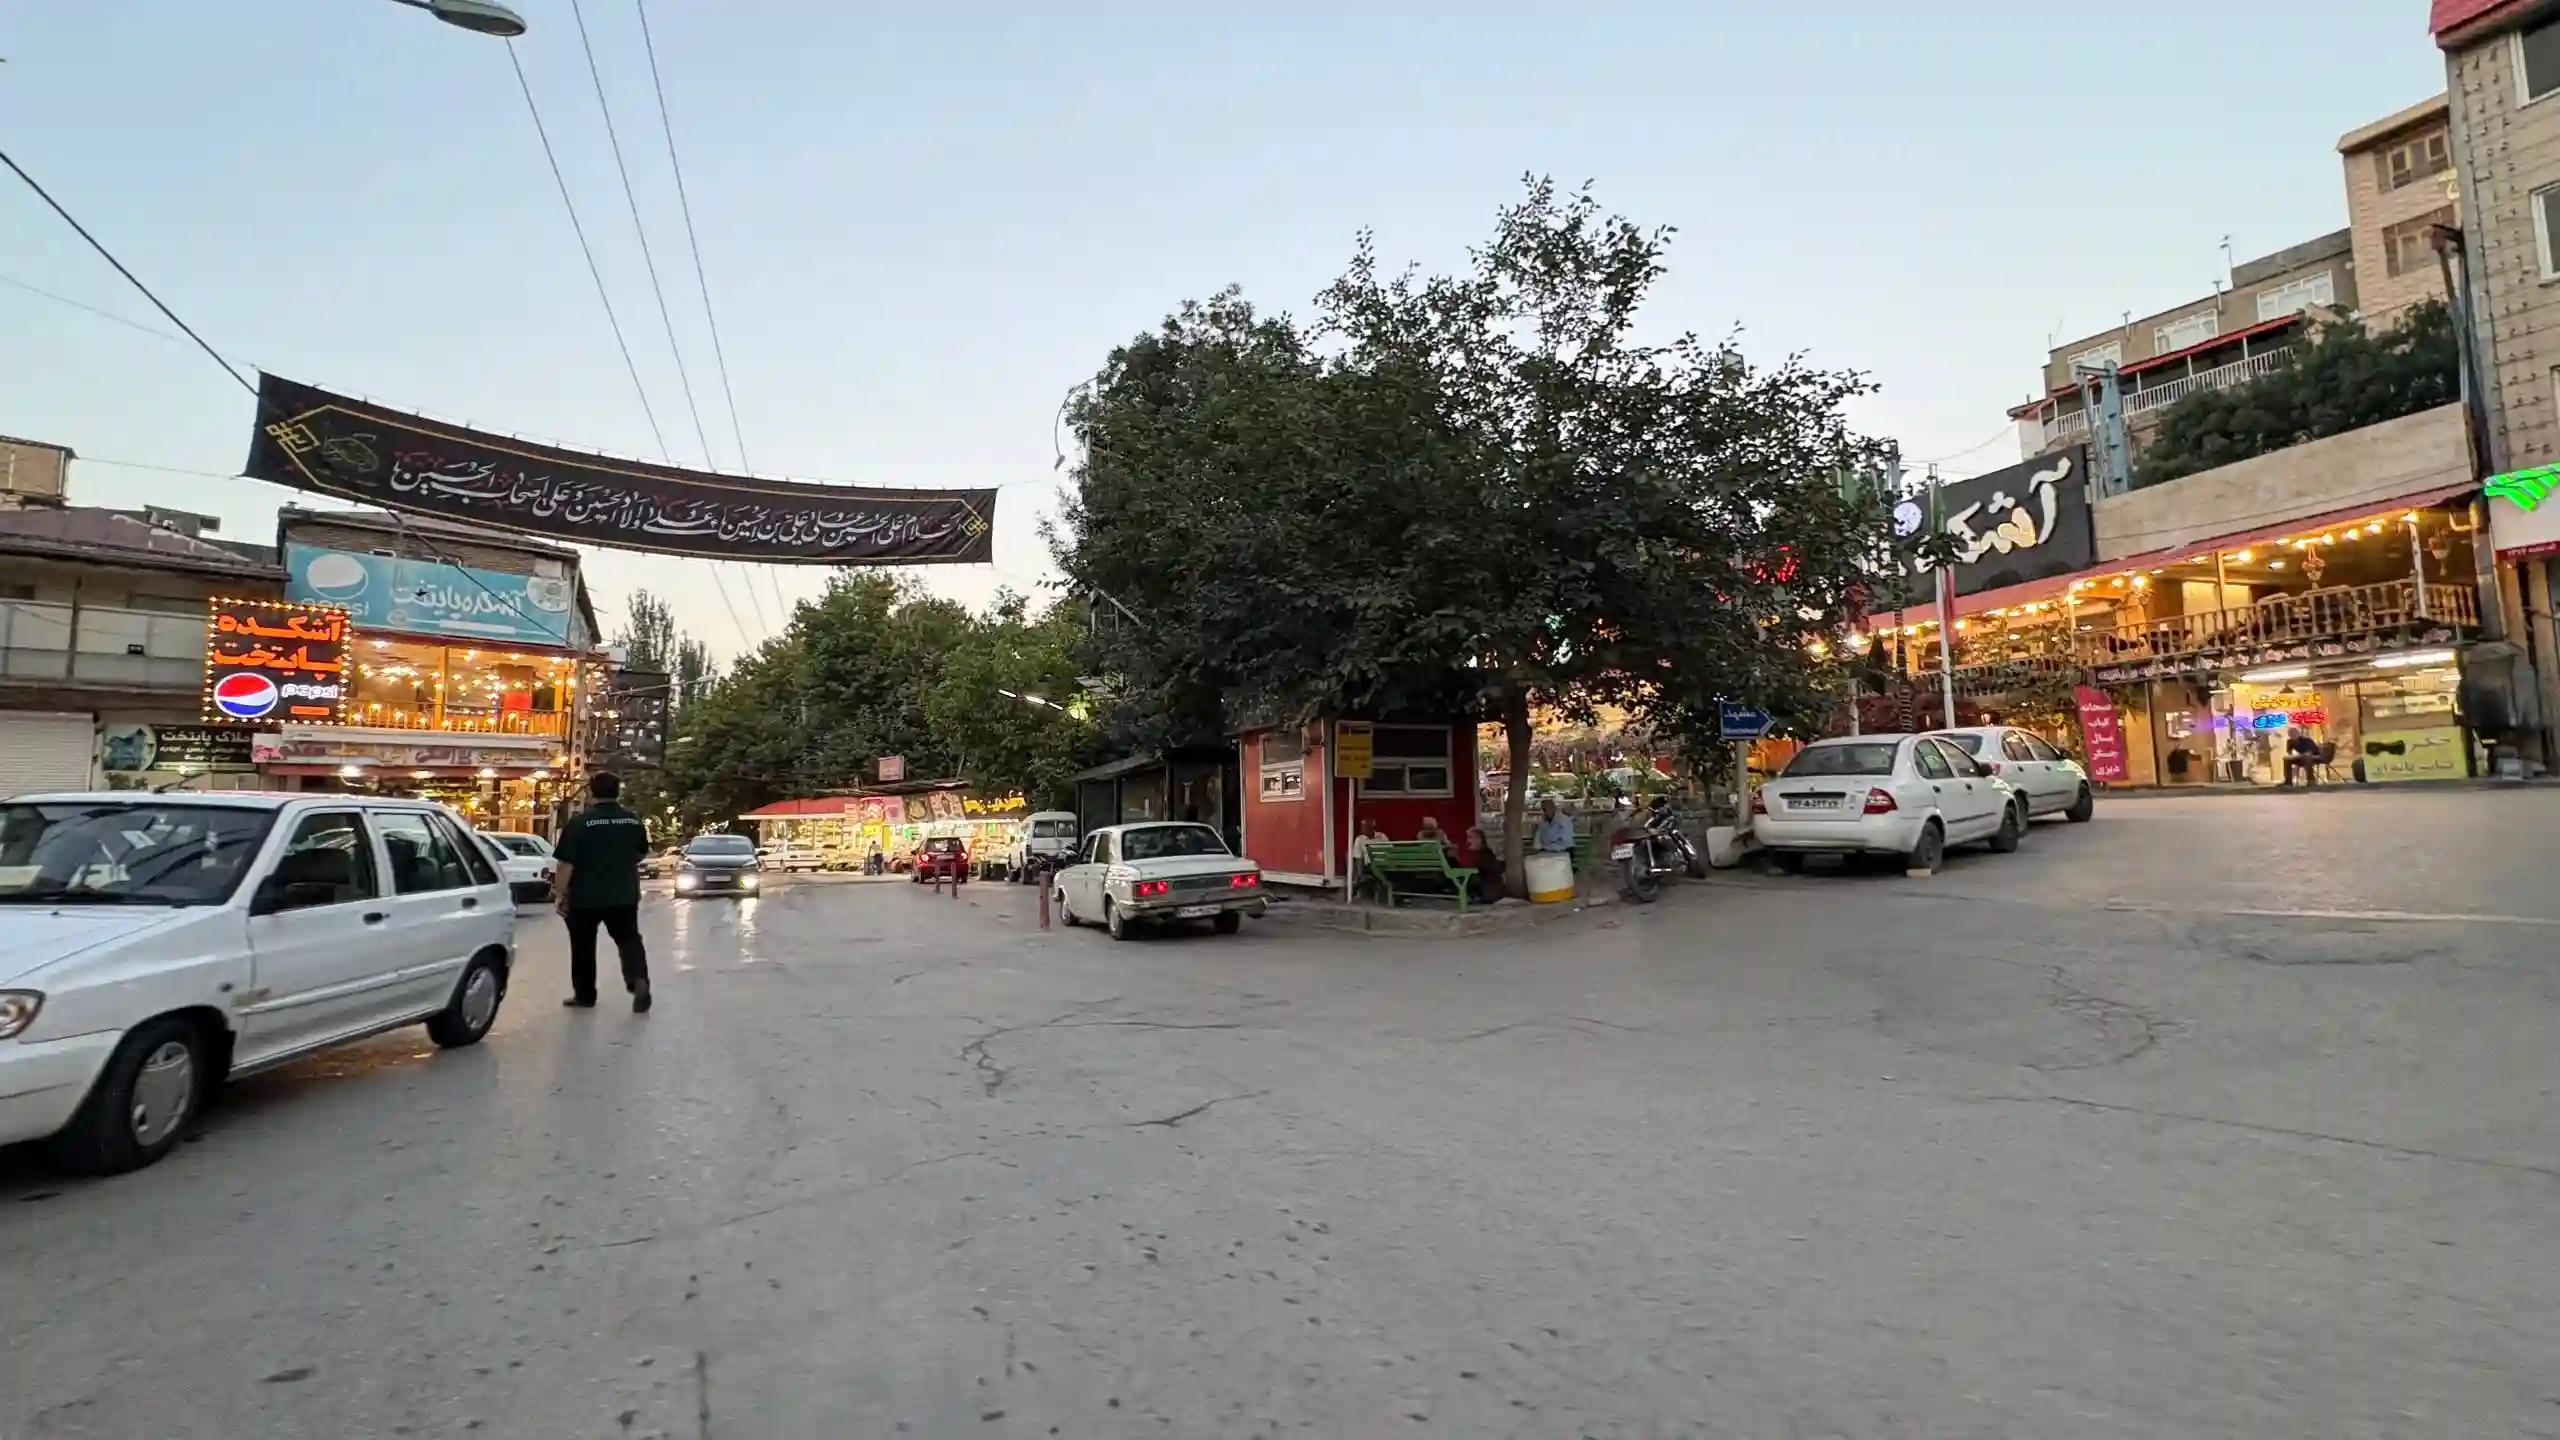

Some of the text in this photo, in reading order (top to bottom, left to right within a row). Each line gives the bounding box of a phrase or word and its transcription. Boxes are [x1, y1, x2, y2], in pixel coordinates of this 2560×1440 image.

[218, 613, 345, 641] آشکده
[213, 643, 343, 681] پایتخت
[281, 683, 338, 699] pepsi
